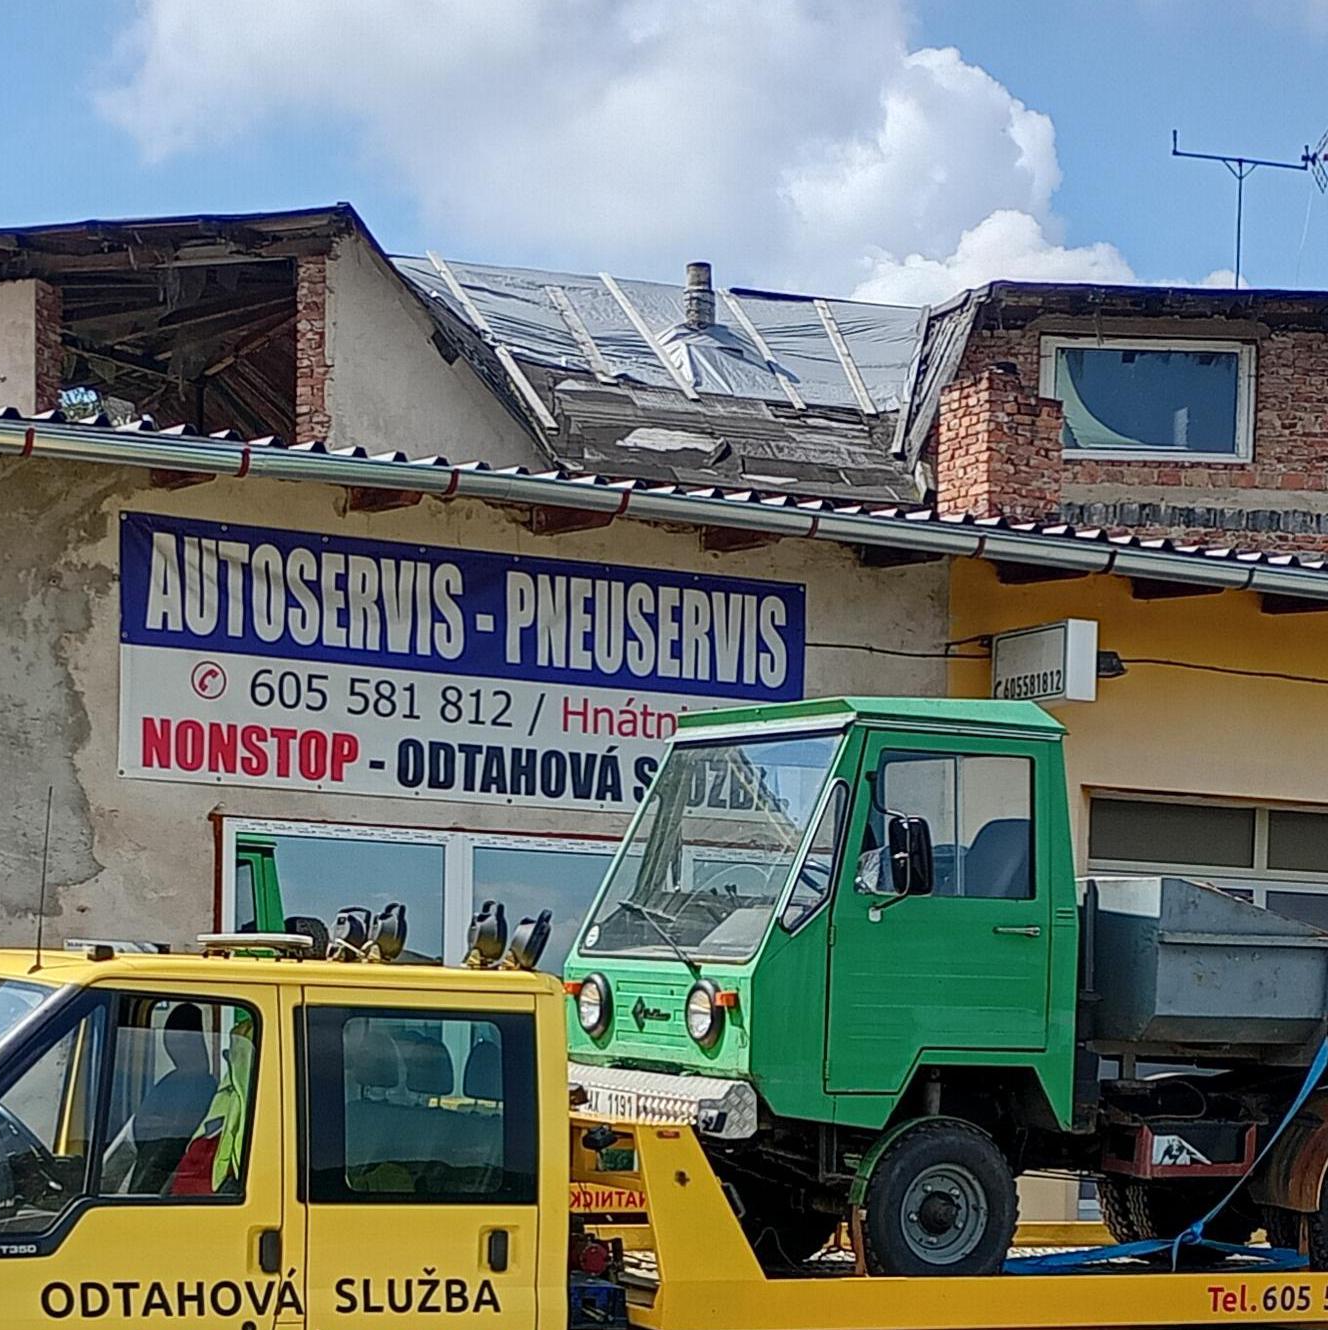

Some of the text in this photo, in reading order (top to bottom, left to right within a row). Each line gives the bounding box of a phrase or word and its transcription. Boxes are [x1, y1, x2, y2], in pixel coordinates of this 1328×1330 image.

[145, 531, 466, 661] AUTOSERVIS
[505, 570, 788, 690] PNEUSERVIS
[249, 668, 329, 713] 605
[347, 677, 420, 721] 581
[440, 685, 513, 729] 812
[562, 696, 688, 739] Hnátn
[1003, 669, 1062, 699] 605581812
[141, 715, 359, 783] NONSTOP
[396, 738, 623, 802] ODTAHOVÁ
[40, 1267, 501, 1319] ODTAHOVÁ SLUŽBA
[1207, 1286, 1257, 1313] Tel.
[1262, 1286, 1312, 1311] 605
